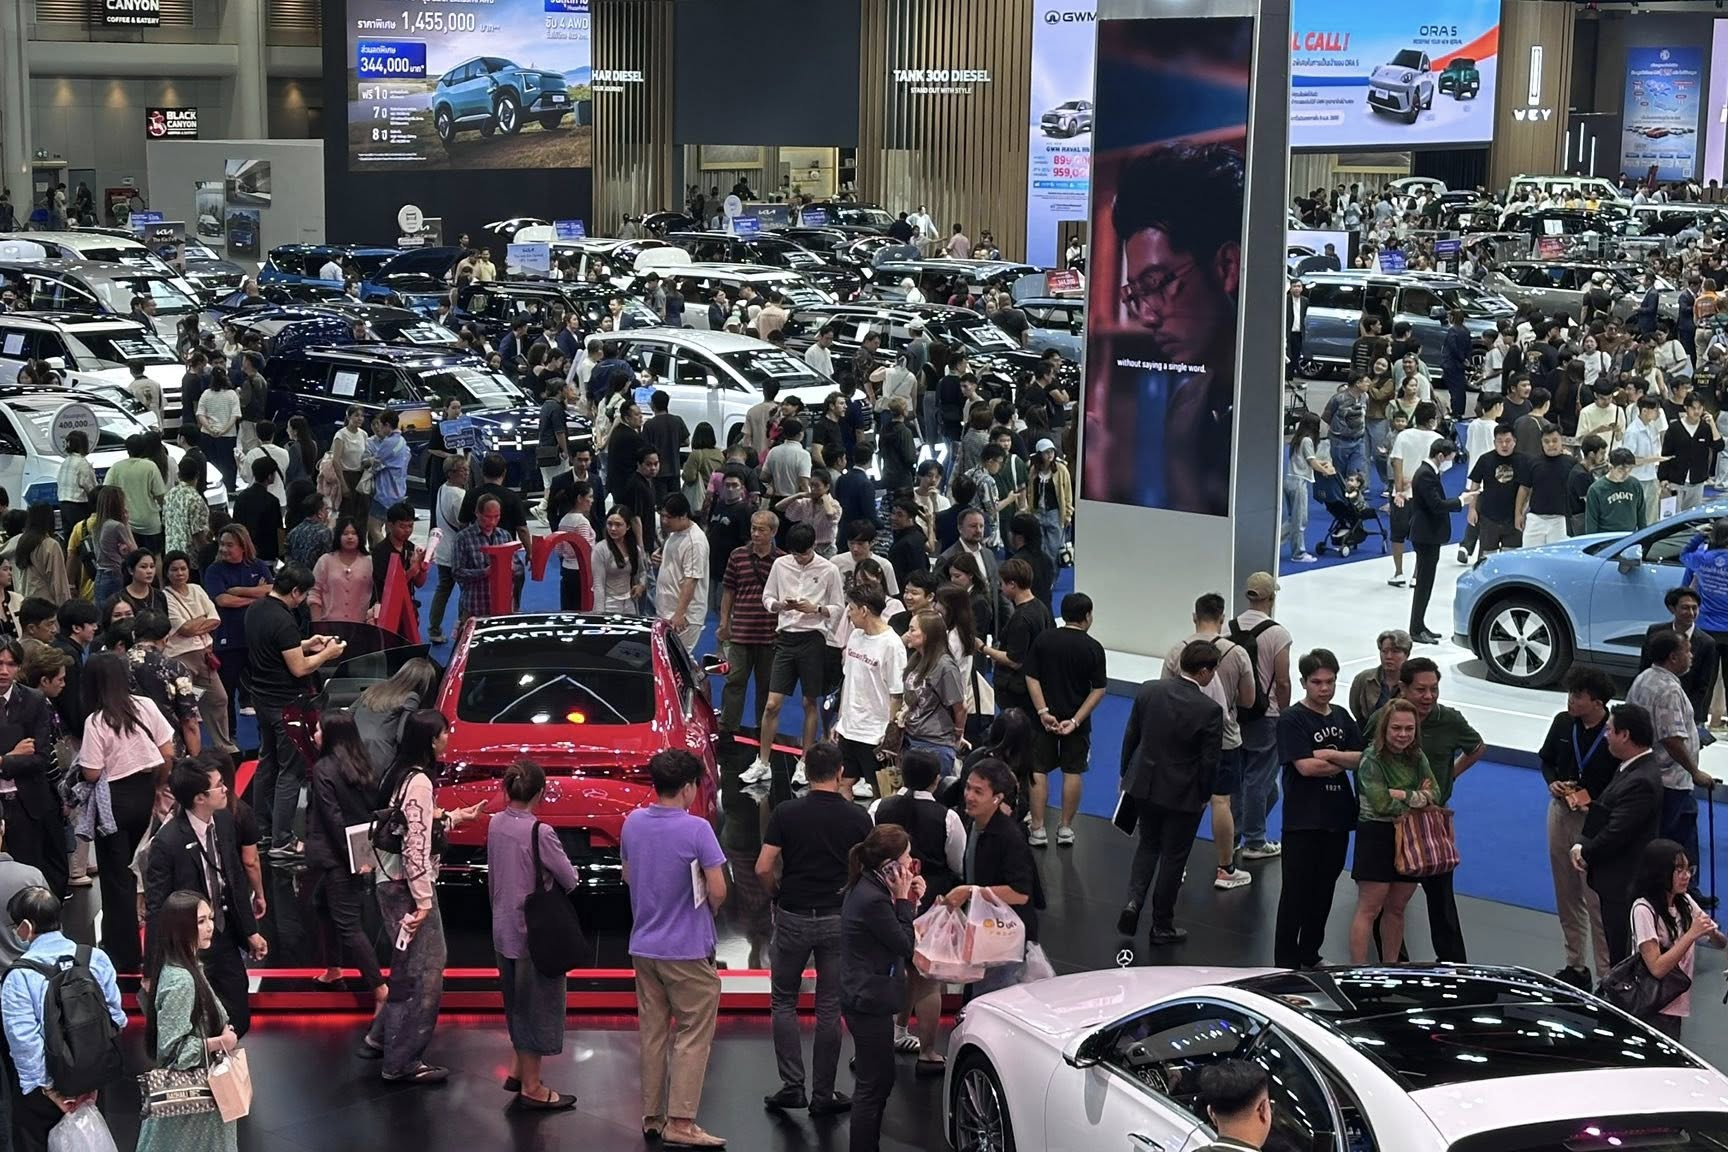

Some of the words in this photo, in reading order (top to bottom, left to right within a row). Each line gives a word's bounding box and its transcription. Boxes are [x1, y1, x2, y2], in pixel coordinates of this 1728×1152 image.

[106, 0, 160, 10] CANYON
[358, 18, 397, 30] ราคาพิเศษ
[402, 11, 476, 35] 1,455,000
[560, 17, 567, 29] 4
[568, 18, 590, 30] AWD
[1420, 25, 1448, 36] ORA
[1451, 25, 1458, 36] 5
[1305, 31, 1351, 51] CALL!
[360, 56, 409, 75] 344,000
[613, 70, 645, 82] DIESEL
[893, 69, 925, 82] TANK
[926, 69, 950, 82] 300
[951, 69, 991, 82] DIESEL
[374, 85, 380, 100] 1
[166, 111, 197, 120] BLACK
[373, 106, 380, 119] 7
[1514, 108, 1552, 121] WEY
[166, 120, 198, 128] CANYON
[372, 127, 380, 141] 8
[1117, 359, 1141, 368] without
[1142, 361, 1163, 371] saying
[1168, 362, 1187, 373] single
[1188, 364, 1207, 373] word.
[59, 420, 89, 430] 400,000
